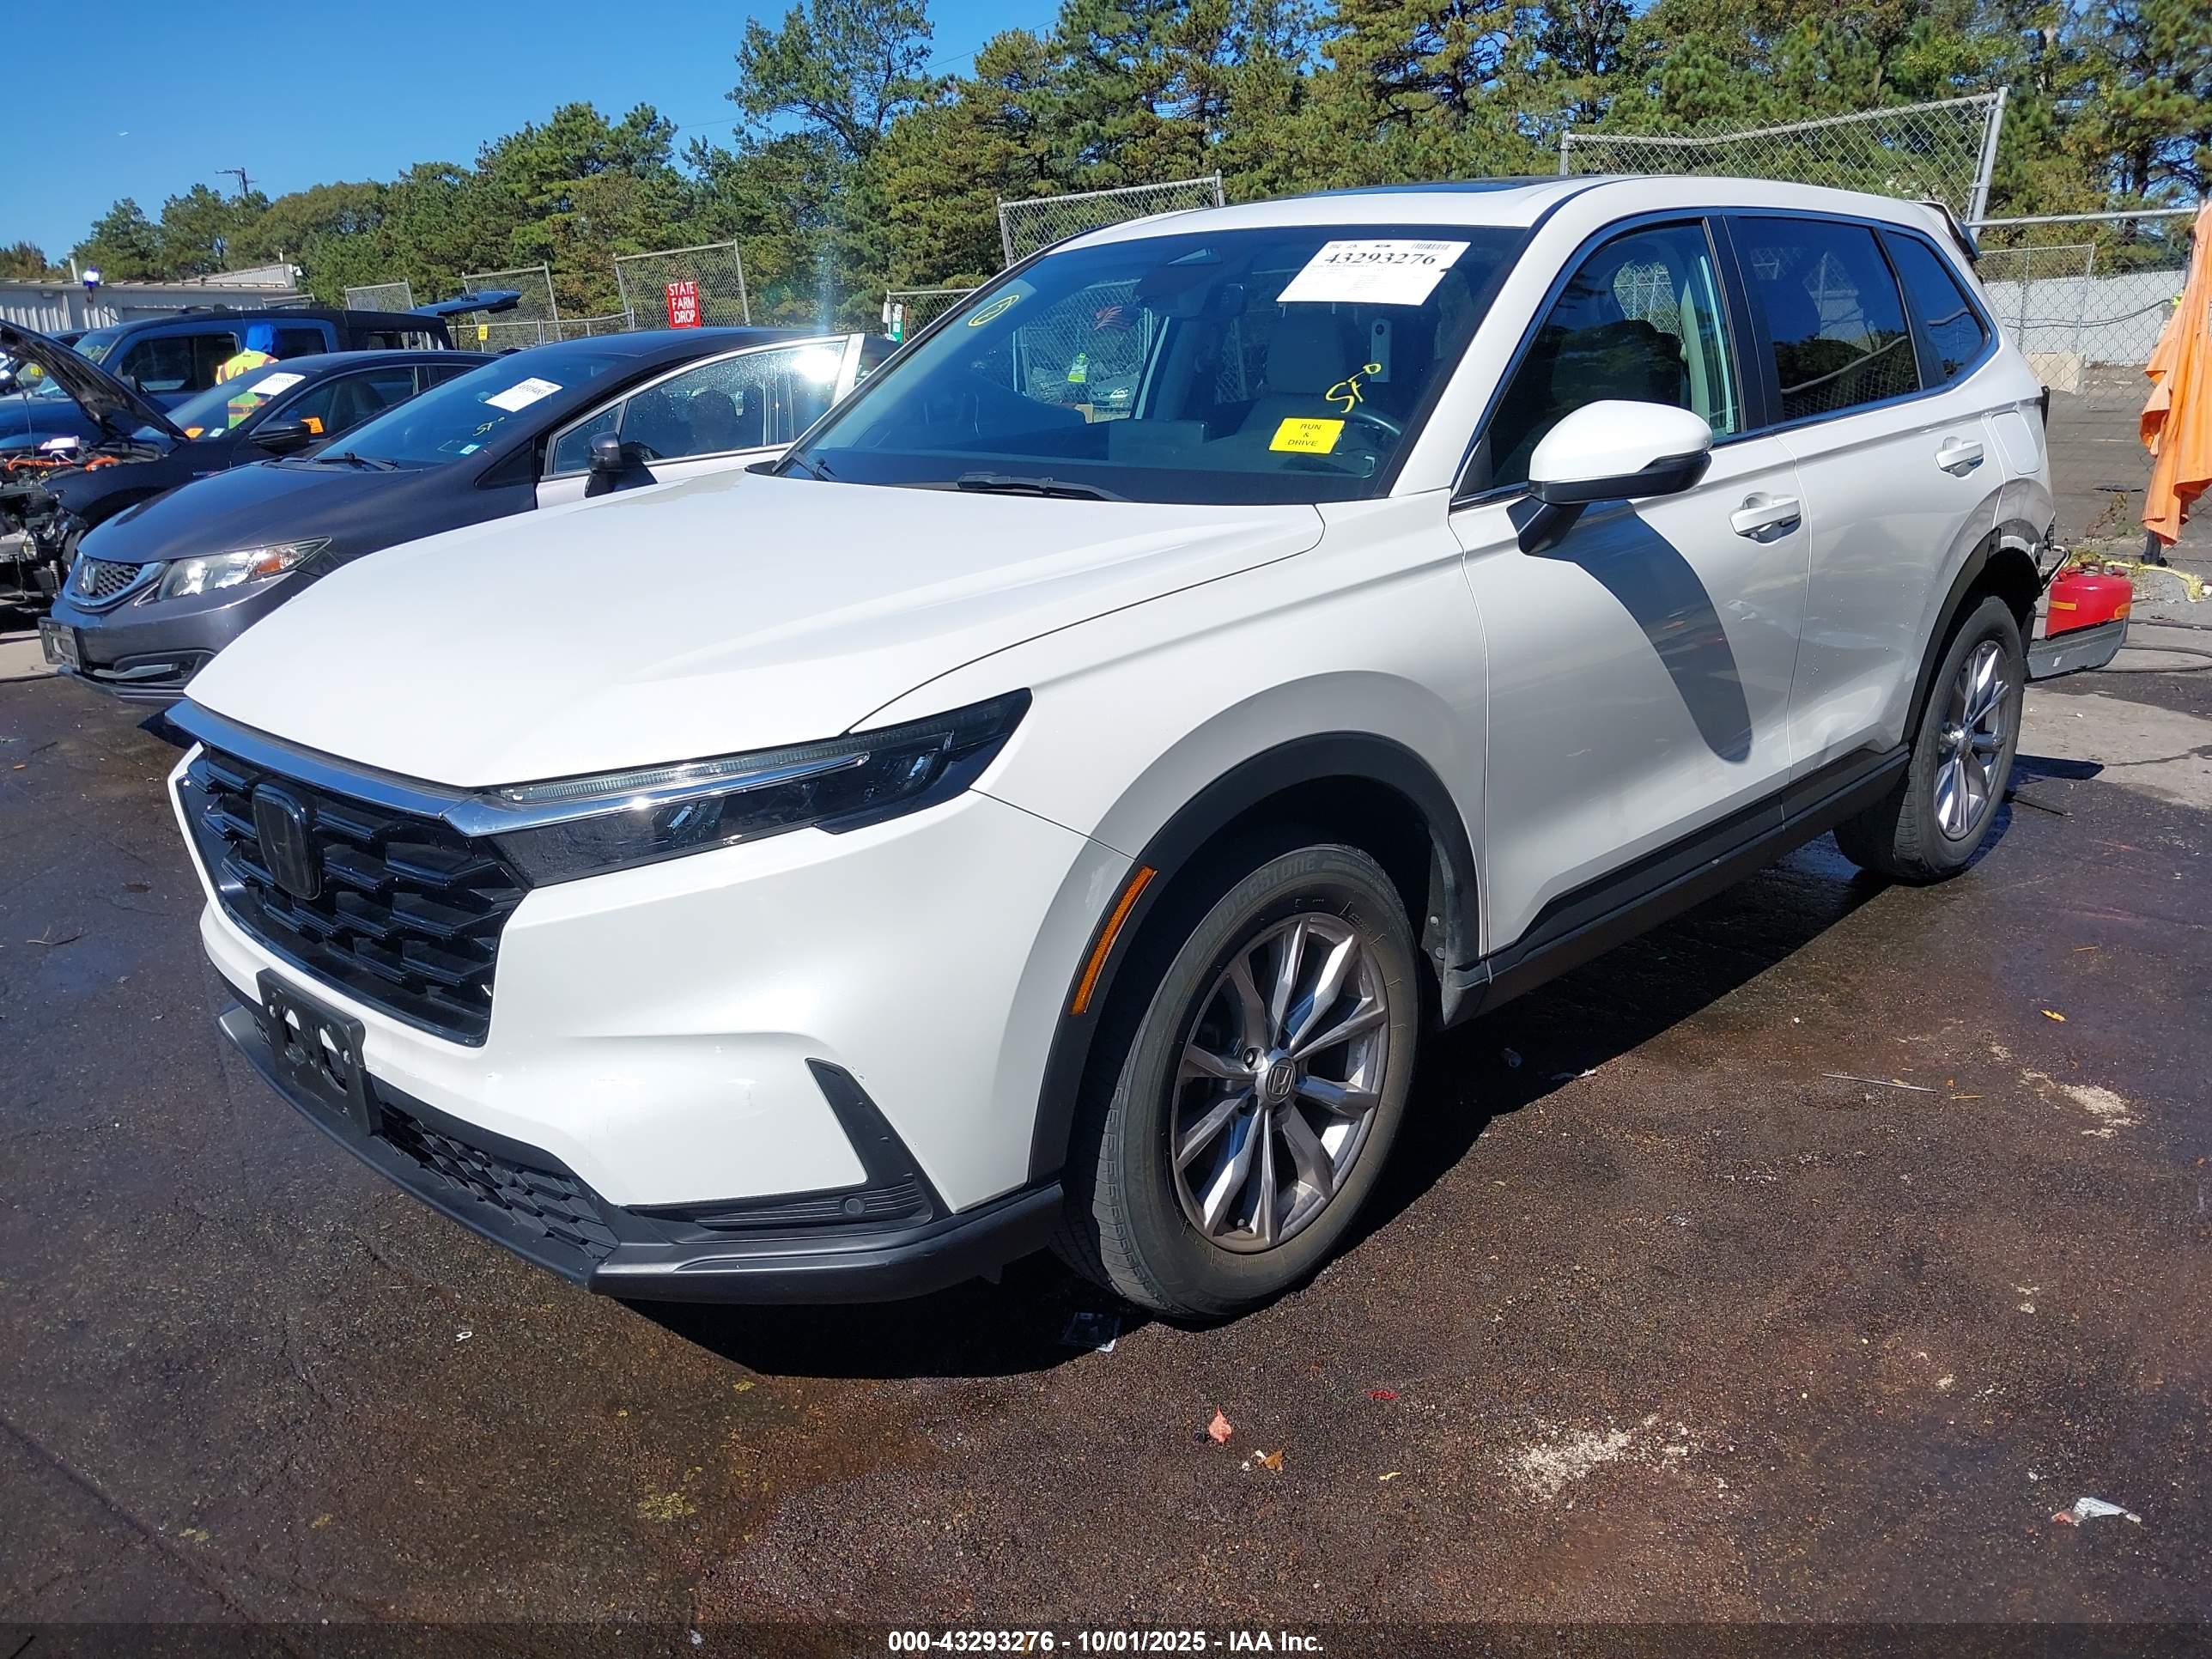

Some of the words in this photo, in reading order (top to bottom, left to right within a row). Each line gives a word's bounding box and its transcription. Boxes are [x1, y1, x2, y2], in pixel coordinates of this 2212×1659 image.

[1324, 252, 1437, 265] 43293276
[668, 282, 695, 296] STATE
[672, 295, 696, 310] FARM
[673, 309, 696, 324] DROP
